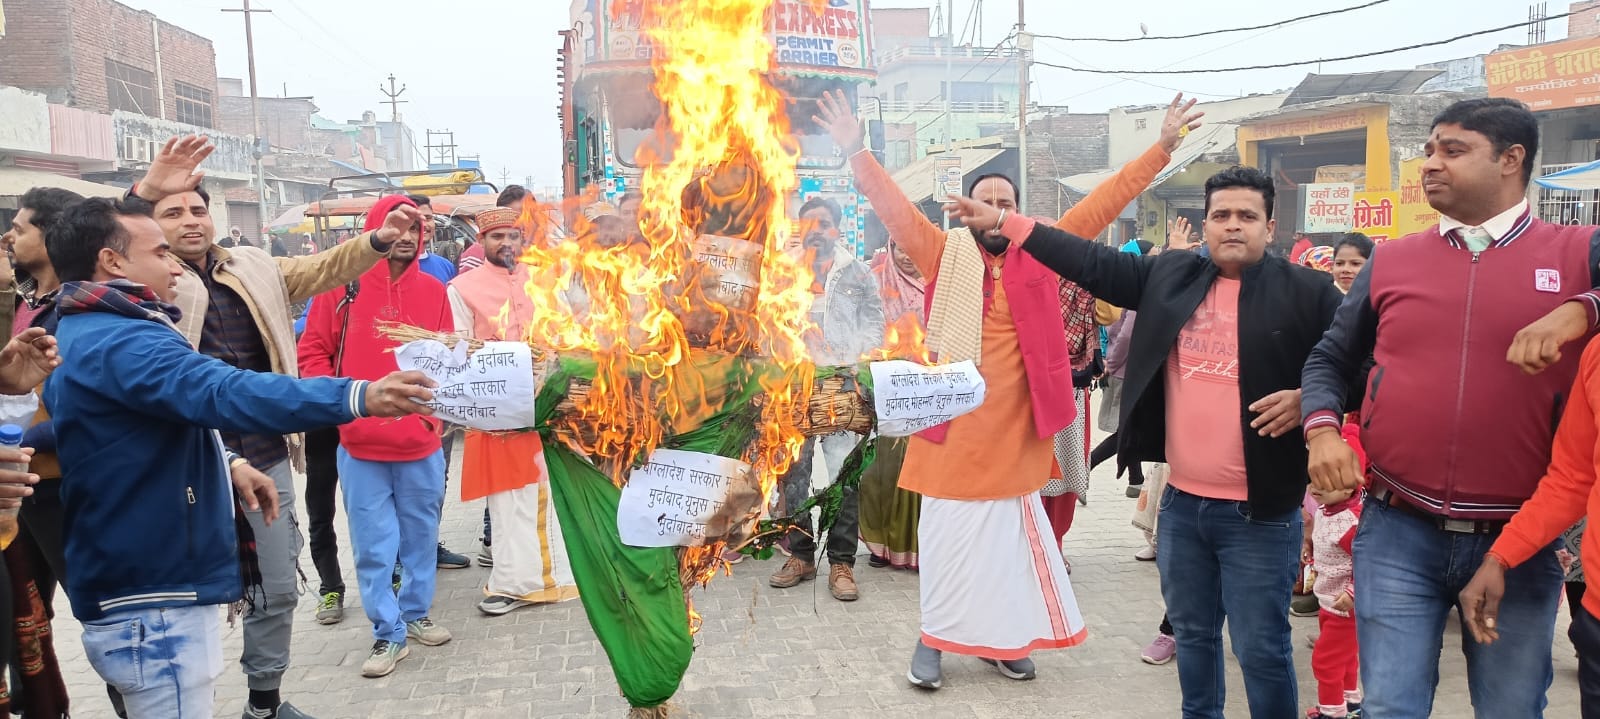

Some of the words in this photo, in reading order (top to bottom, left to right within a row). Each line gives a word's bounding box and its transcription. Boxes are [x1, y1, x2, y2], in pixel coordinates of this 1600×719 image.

[775, 1, 857, 38] EXPRESS
[776, 36, 833, 50] PERMIT
[779, 50, 838, 65] ARRIER
[1309, 200, 1350, 216] बीयर
[477, 348, 519, 374] मुर्दाबाद,
[470, 379, 506, 397] सरकार
[643, 458, 685, 481] बांग्लादेश
[689, 469, 722, 488] सरकार
[685, 494, 709, 516] यूनुस
